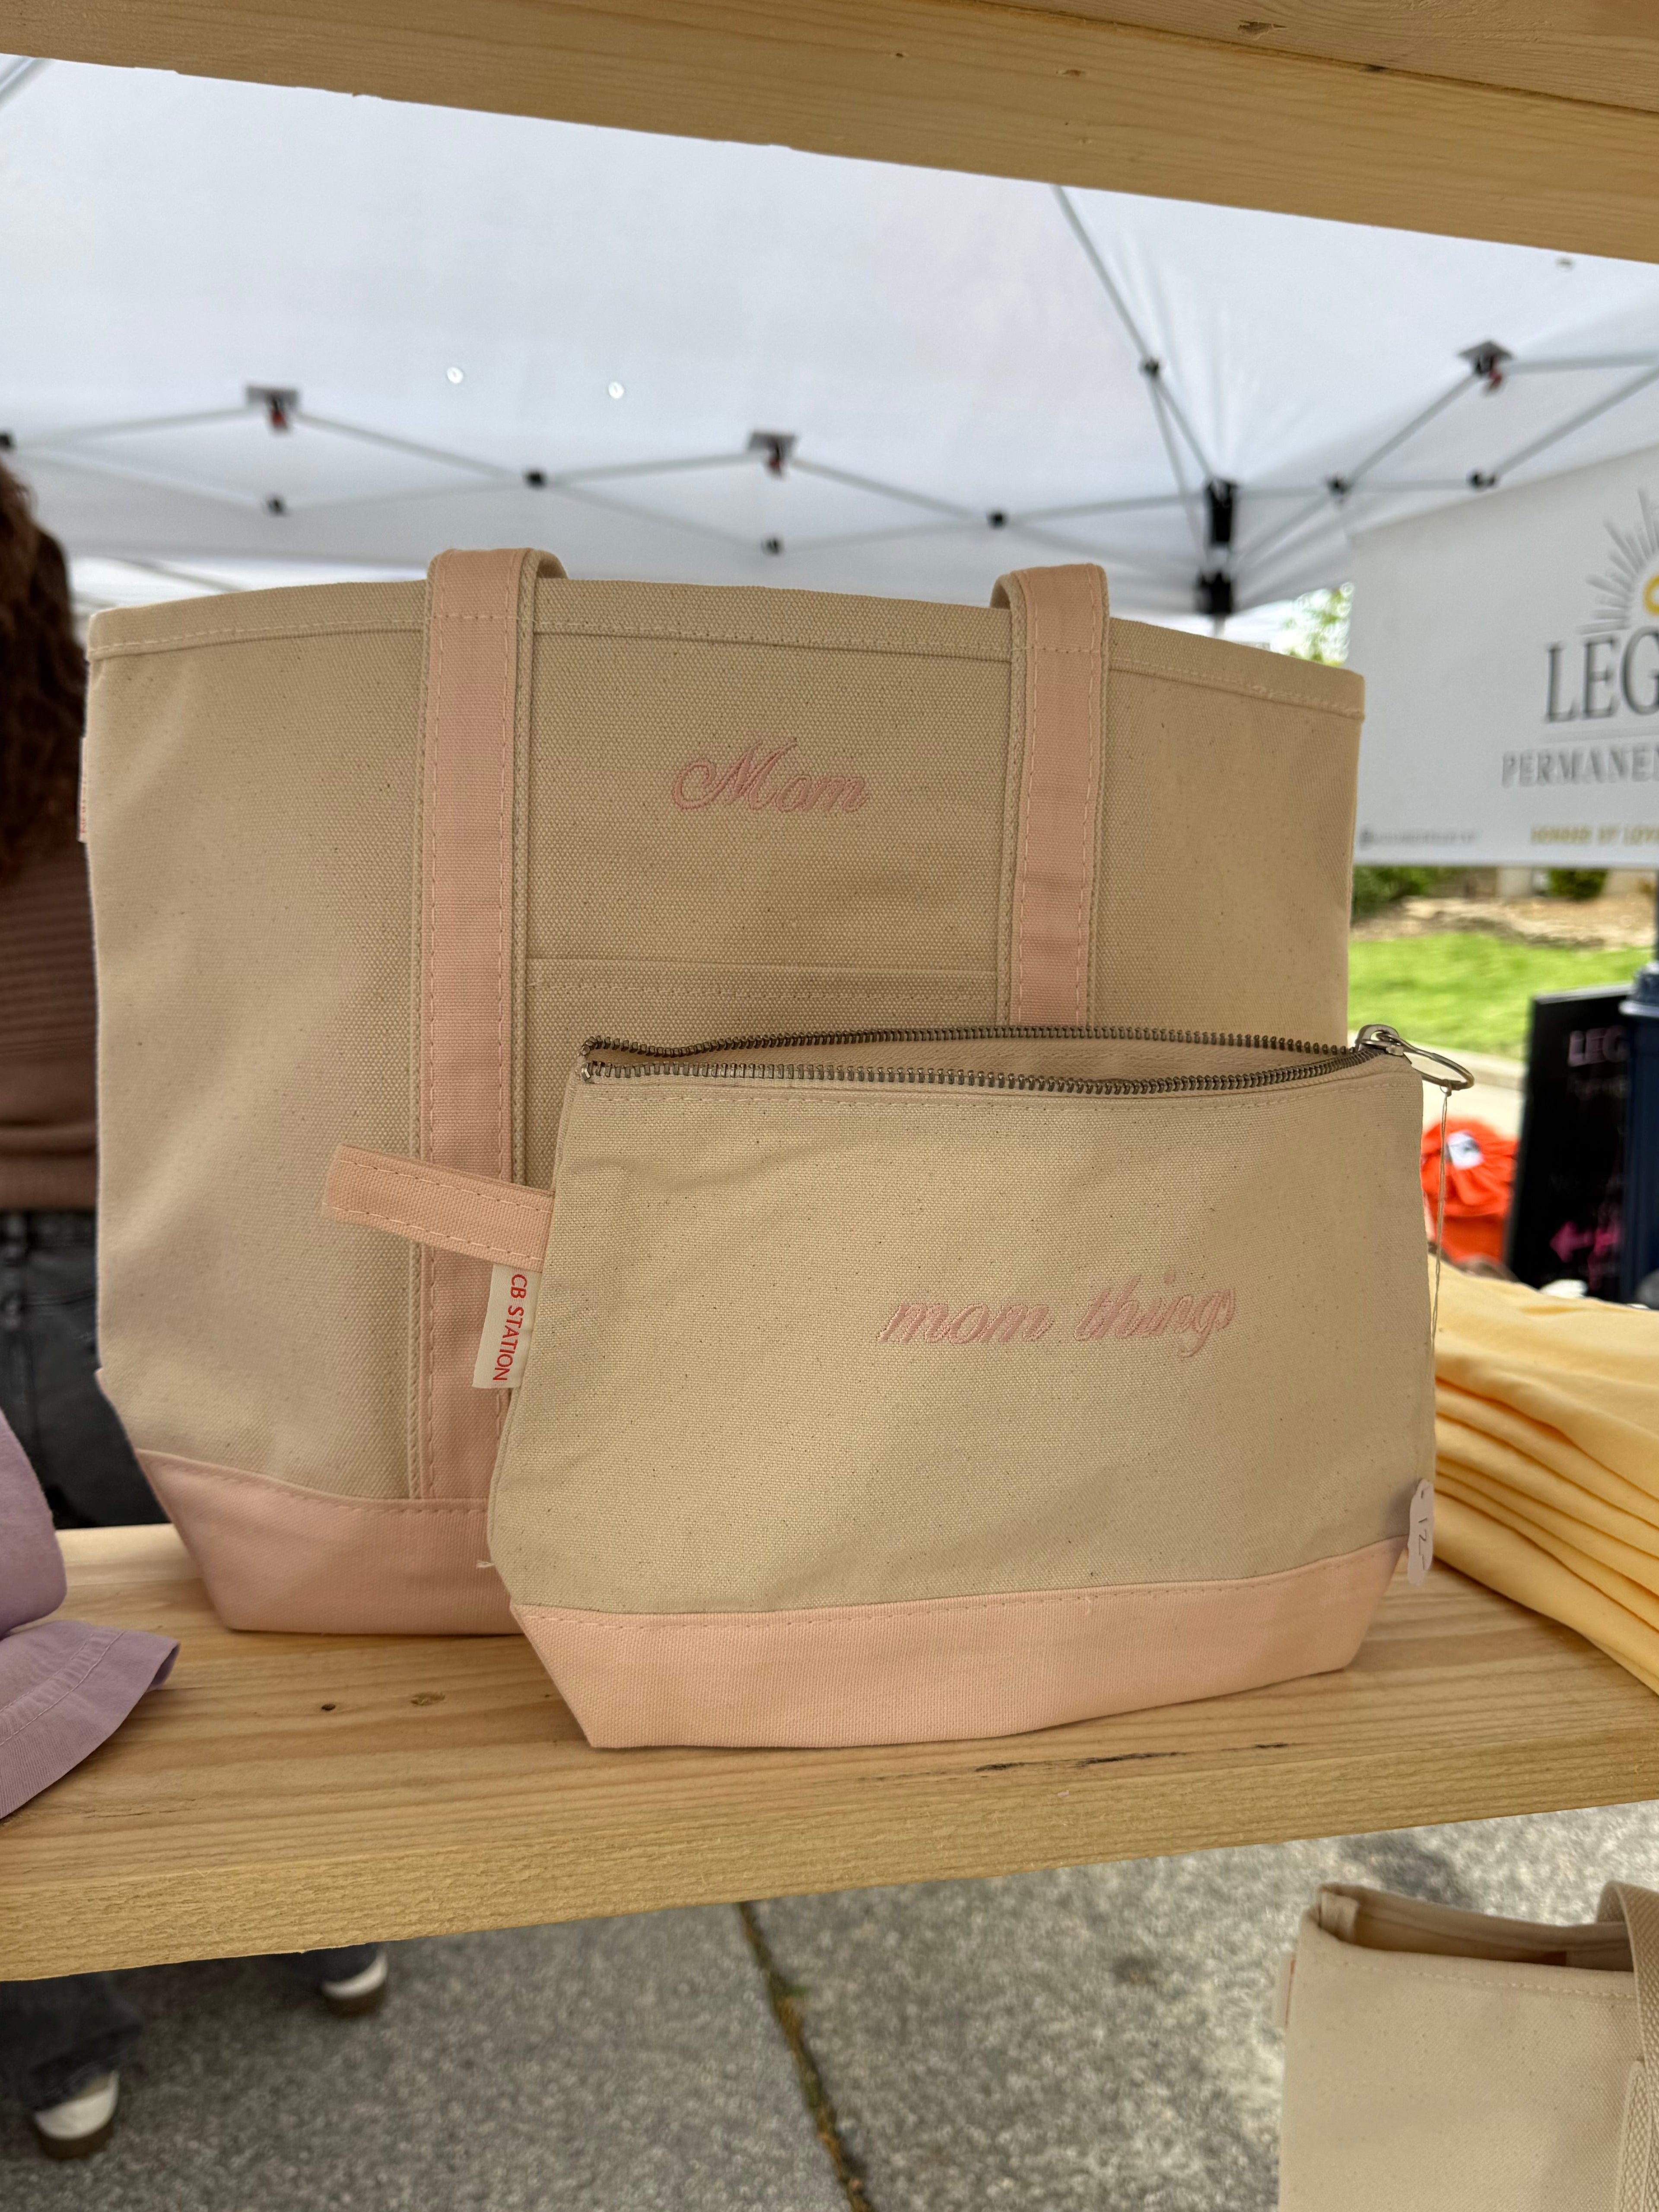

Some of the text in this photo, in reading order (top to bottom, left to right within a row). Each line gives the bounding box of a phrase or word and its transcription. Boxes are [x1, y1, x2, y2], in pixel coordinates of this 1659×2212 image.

[671, 740, 870, 813] Mom
[1502, 743, 1659, 787] PERMANE
[493, 1274, 527, 1381] CB STATION
[877, 1272, 1236, 1359] mom thing
